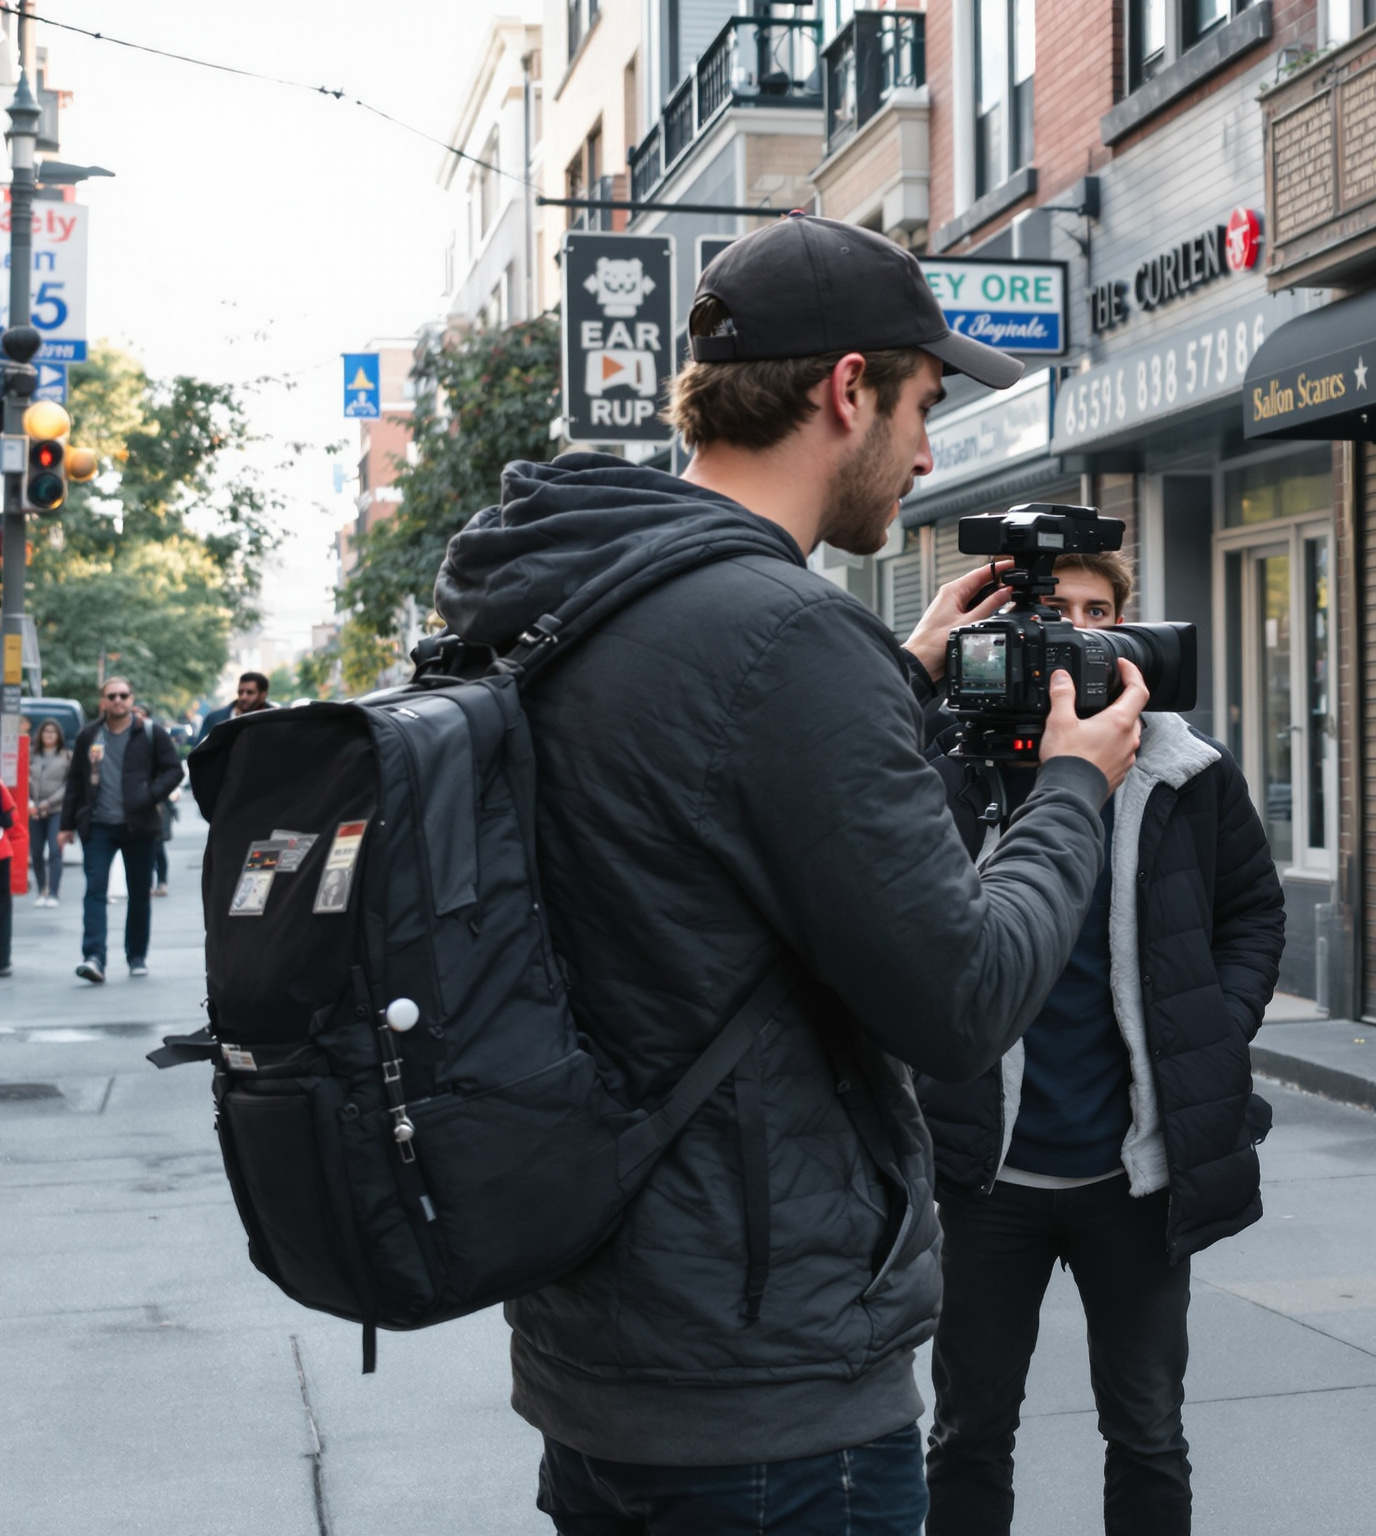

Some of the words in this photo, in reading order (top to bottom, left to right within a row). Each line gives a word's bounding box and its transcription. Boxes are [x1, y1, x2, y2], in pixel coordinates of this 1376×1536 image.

[981, 274, 1053, 304] ORE
[581, 321, 661, 350] EAR
[590, 399, 655, 426] RUP
